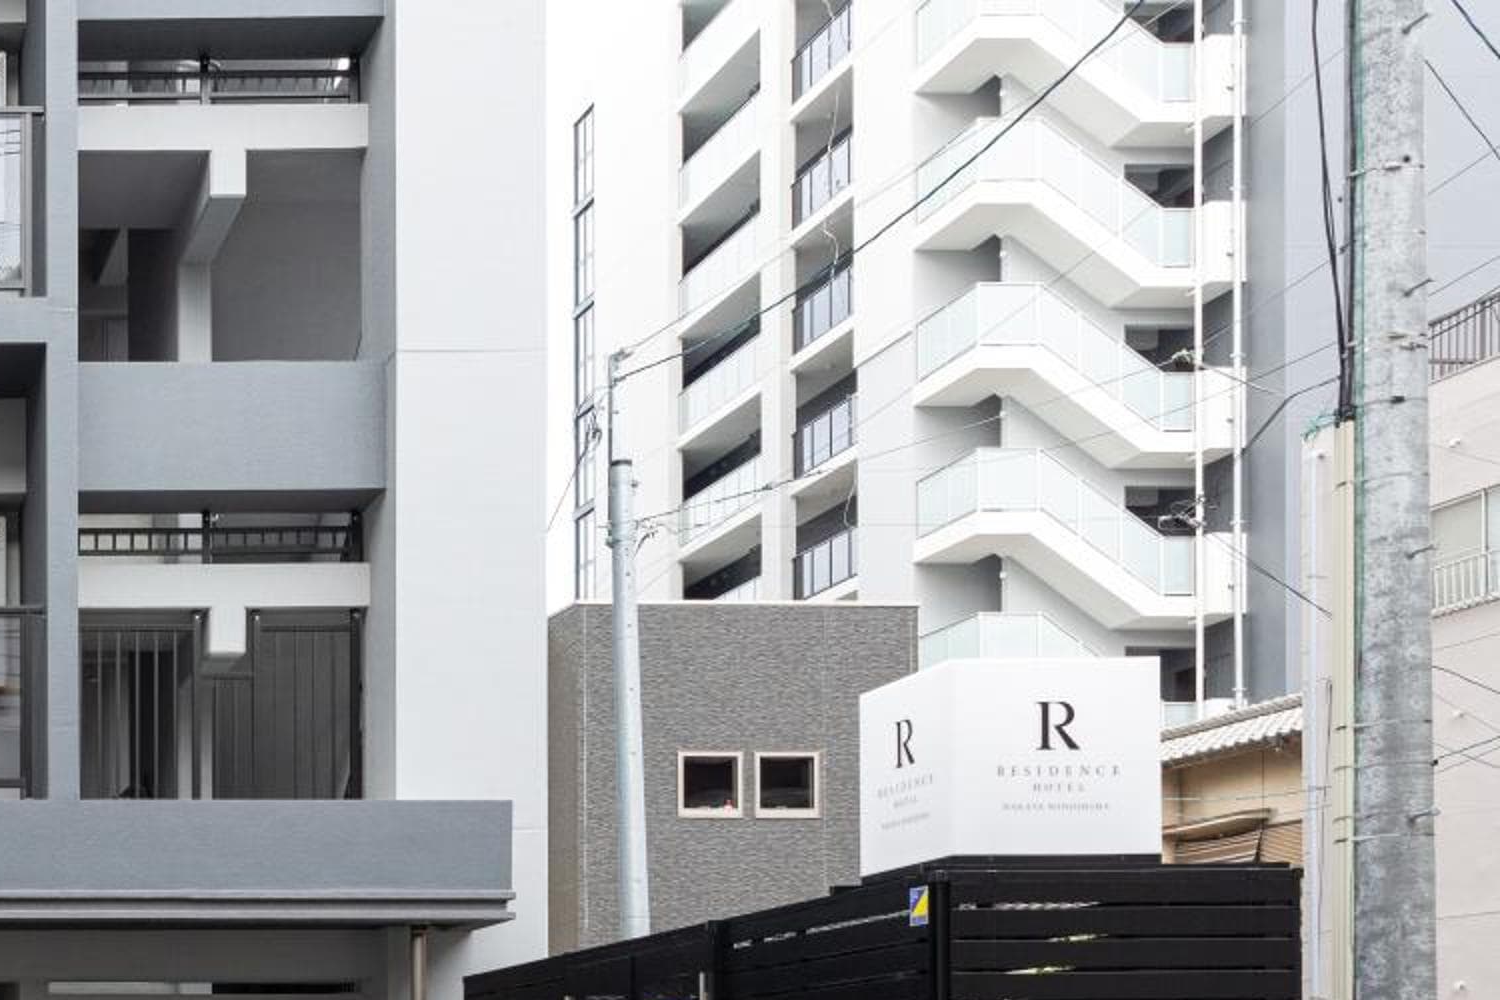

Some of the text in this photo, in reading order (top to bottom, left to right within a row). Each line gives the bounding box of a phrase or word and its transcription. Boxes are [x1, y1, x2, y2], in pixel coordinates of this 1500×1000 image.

[1035, 700, 1081, 751] R
[893, 718, 916, 768] R
[997, 765, 1121, 777] RESIDENCE
[1032, 783, 1085, 793] HOTEL
